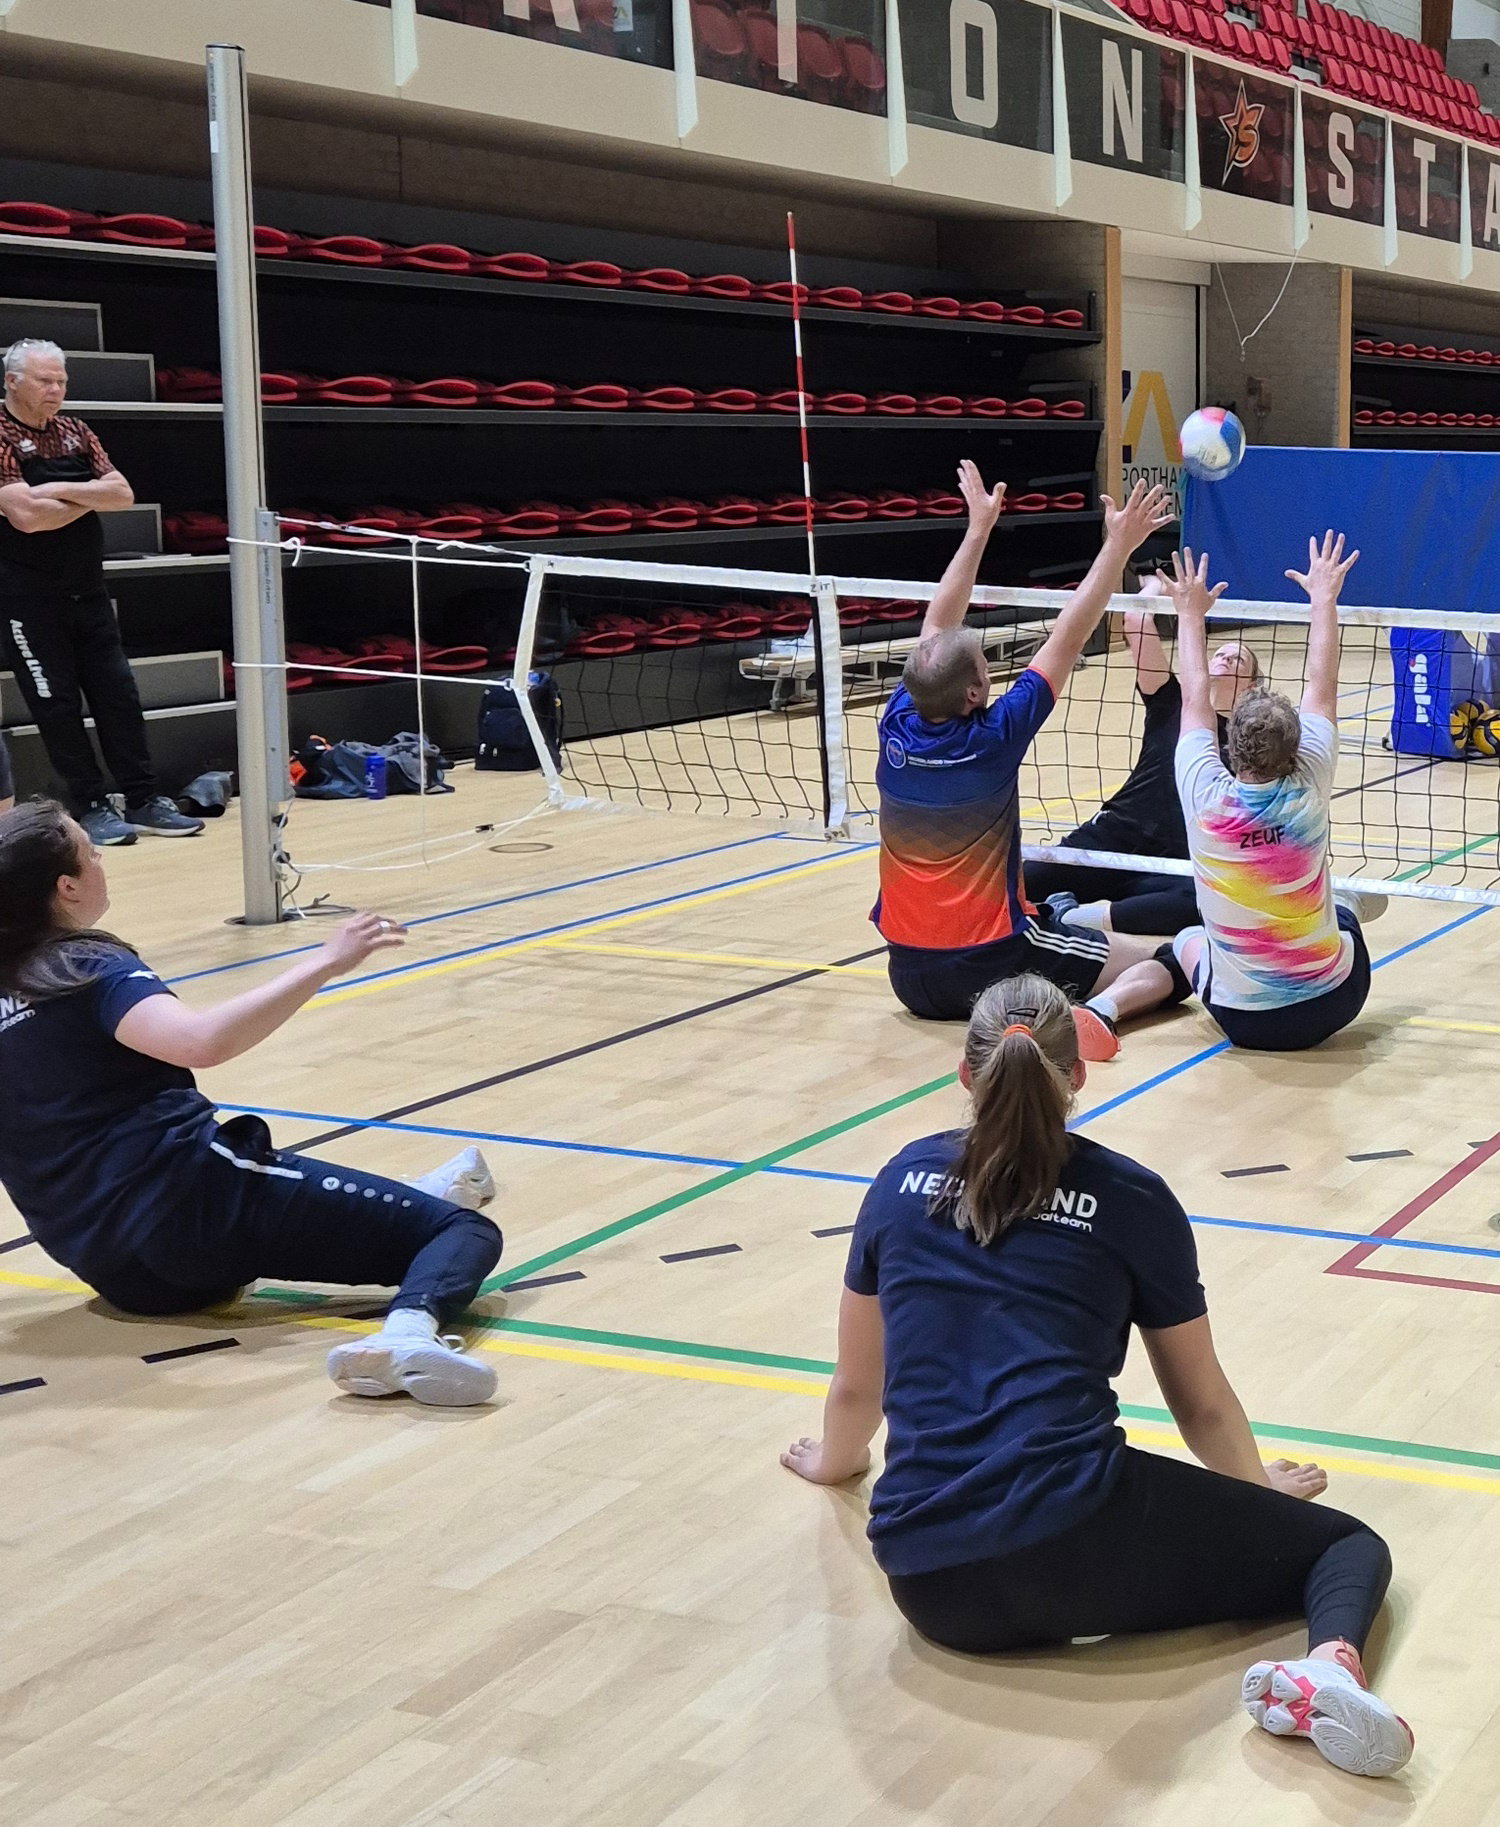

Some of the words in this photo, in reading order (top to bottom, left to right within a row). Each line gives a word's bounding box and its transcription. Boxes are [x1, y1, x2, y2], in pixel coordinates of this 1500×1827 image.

[10, 619, 33, 658] Active
[26, 659, 53, 698] Living
[1239, 824, 1286, 850] ZEUF
